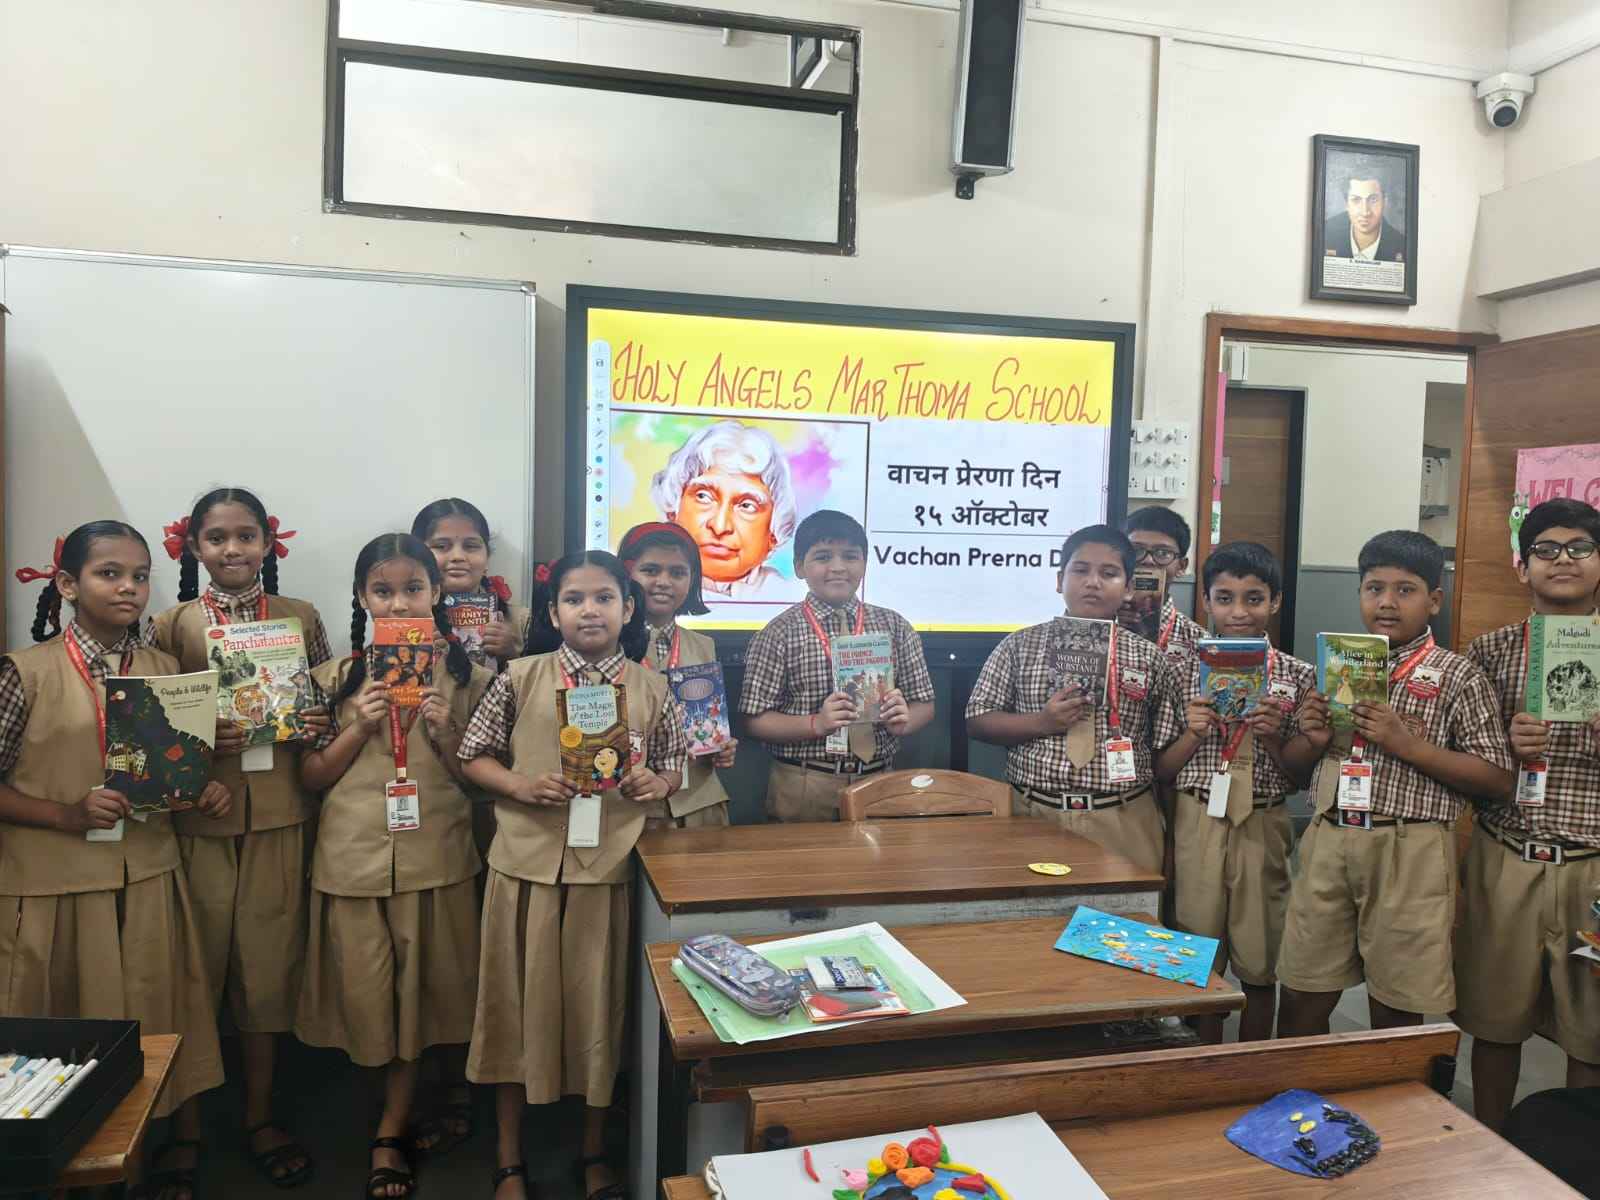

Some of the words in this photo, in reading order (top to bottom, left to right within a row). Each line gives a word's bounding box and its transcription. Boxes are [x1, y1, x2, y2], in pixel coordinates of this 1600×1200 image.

[612, 340, 688, 407] HOLY
[697, 351, 813, 410] ANGELS
[893, 361, 971, 421] THOMA
[985, 356, 1101, 424] SCHOOL
[887, 464, 949, 486] वाचन
[956, 459, 1015, 488] प्रेरणा
[1021, 461, 1062, 490] दिन
[914, 504, 943, 527] १५
[951, 498, 1049, 527] ऑक्टोबर
[873, 544, 961, 567] Vachan
[967, 547, 1042, 568] Prerna
[222, 634, 301, 652] Panchatantra
[1557, 626, 1591, 638] Malgudi
